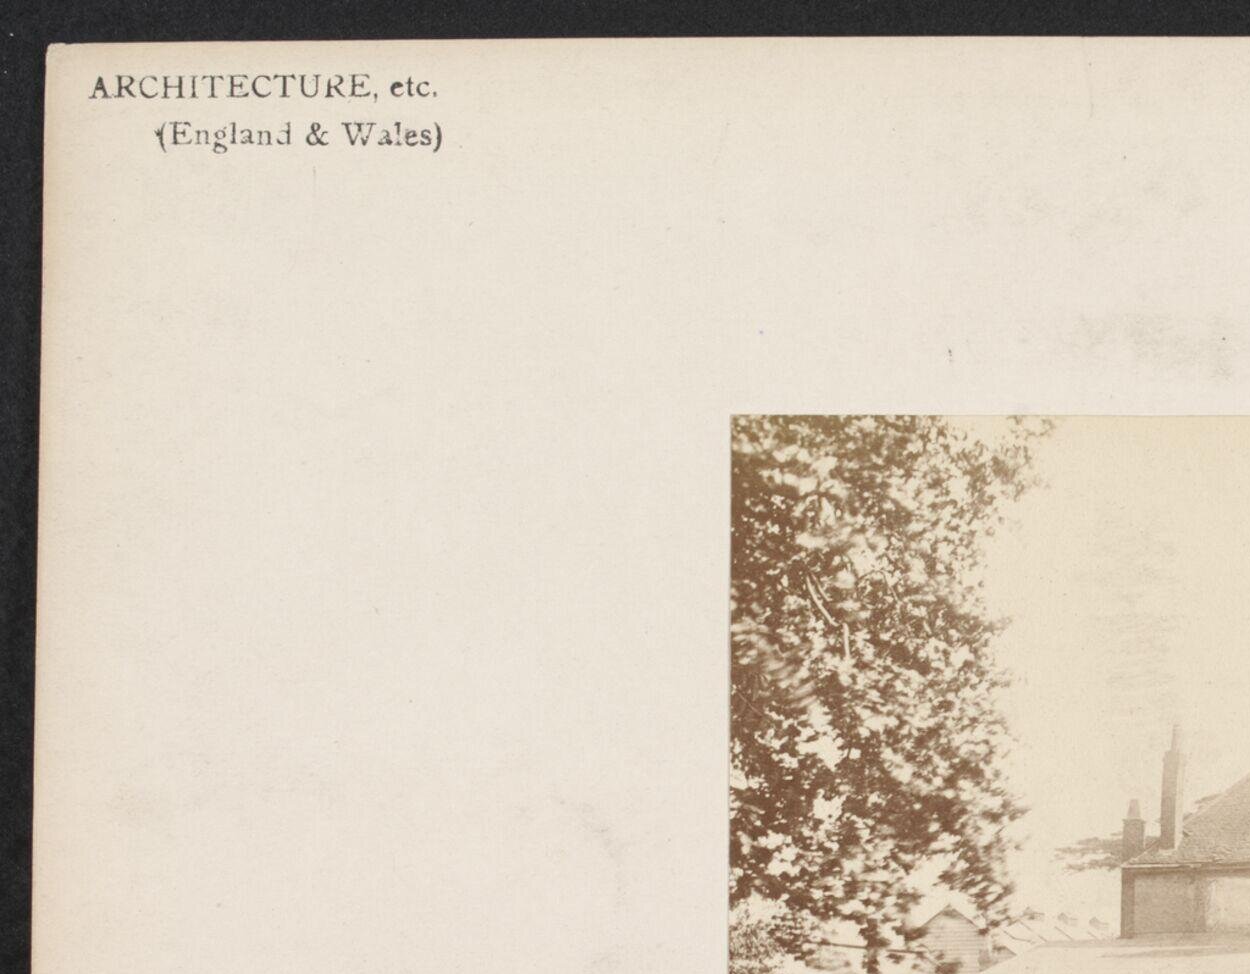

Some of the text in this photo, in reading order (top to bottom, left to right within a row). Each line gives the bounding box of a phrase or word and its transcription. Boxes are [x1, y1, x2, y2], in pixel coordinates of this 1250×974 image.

[88, 74, 437, 103] ARCHITECTURE, etc.
[154, 121, 442, 154] (England & Wales)
